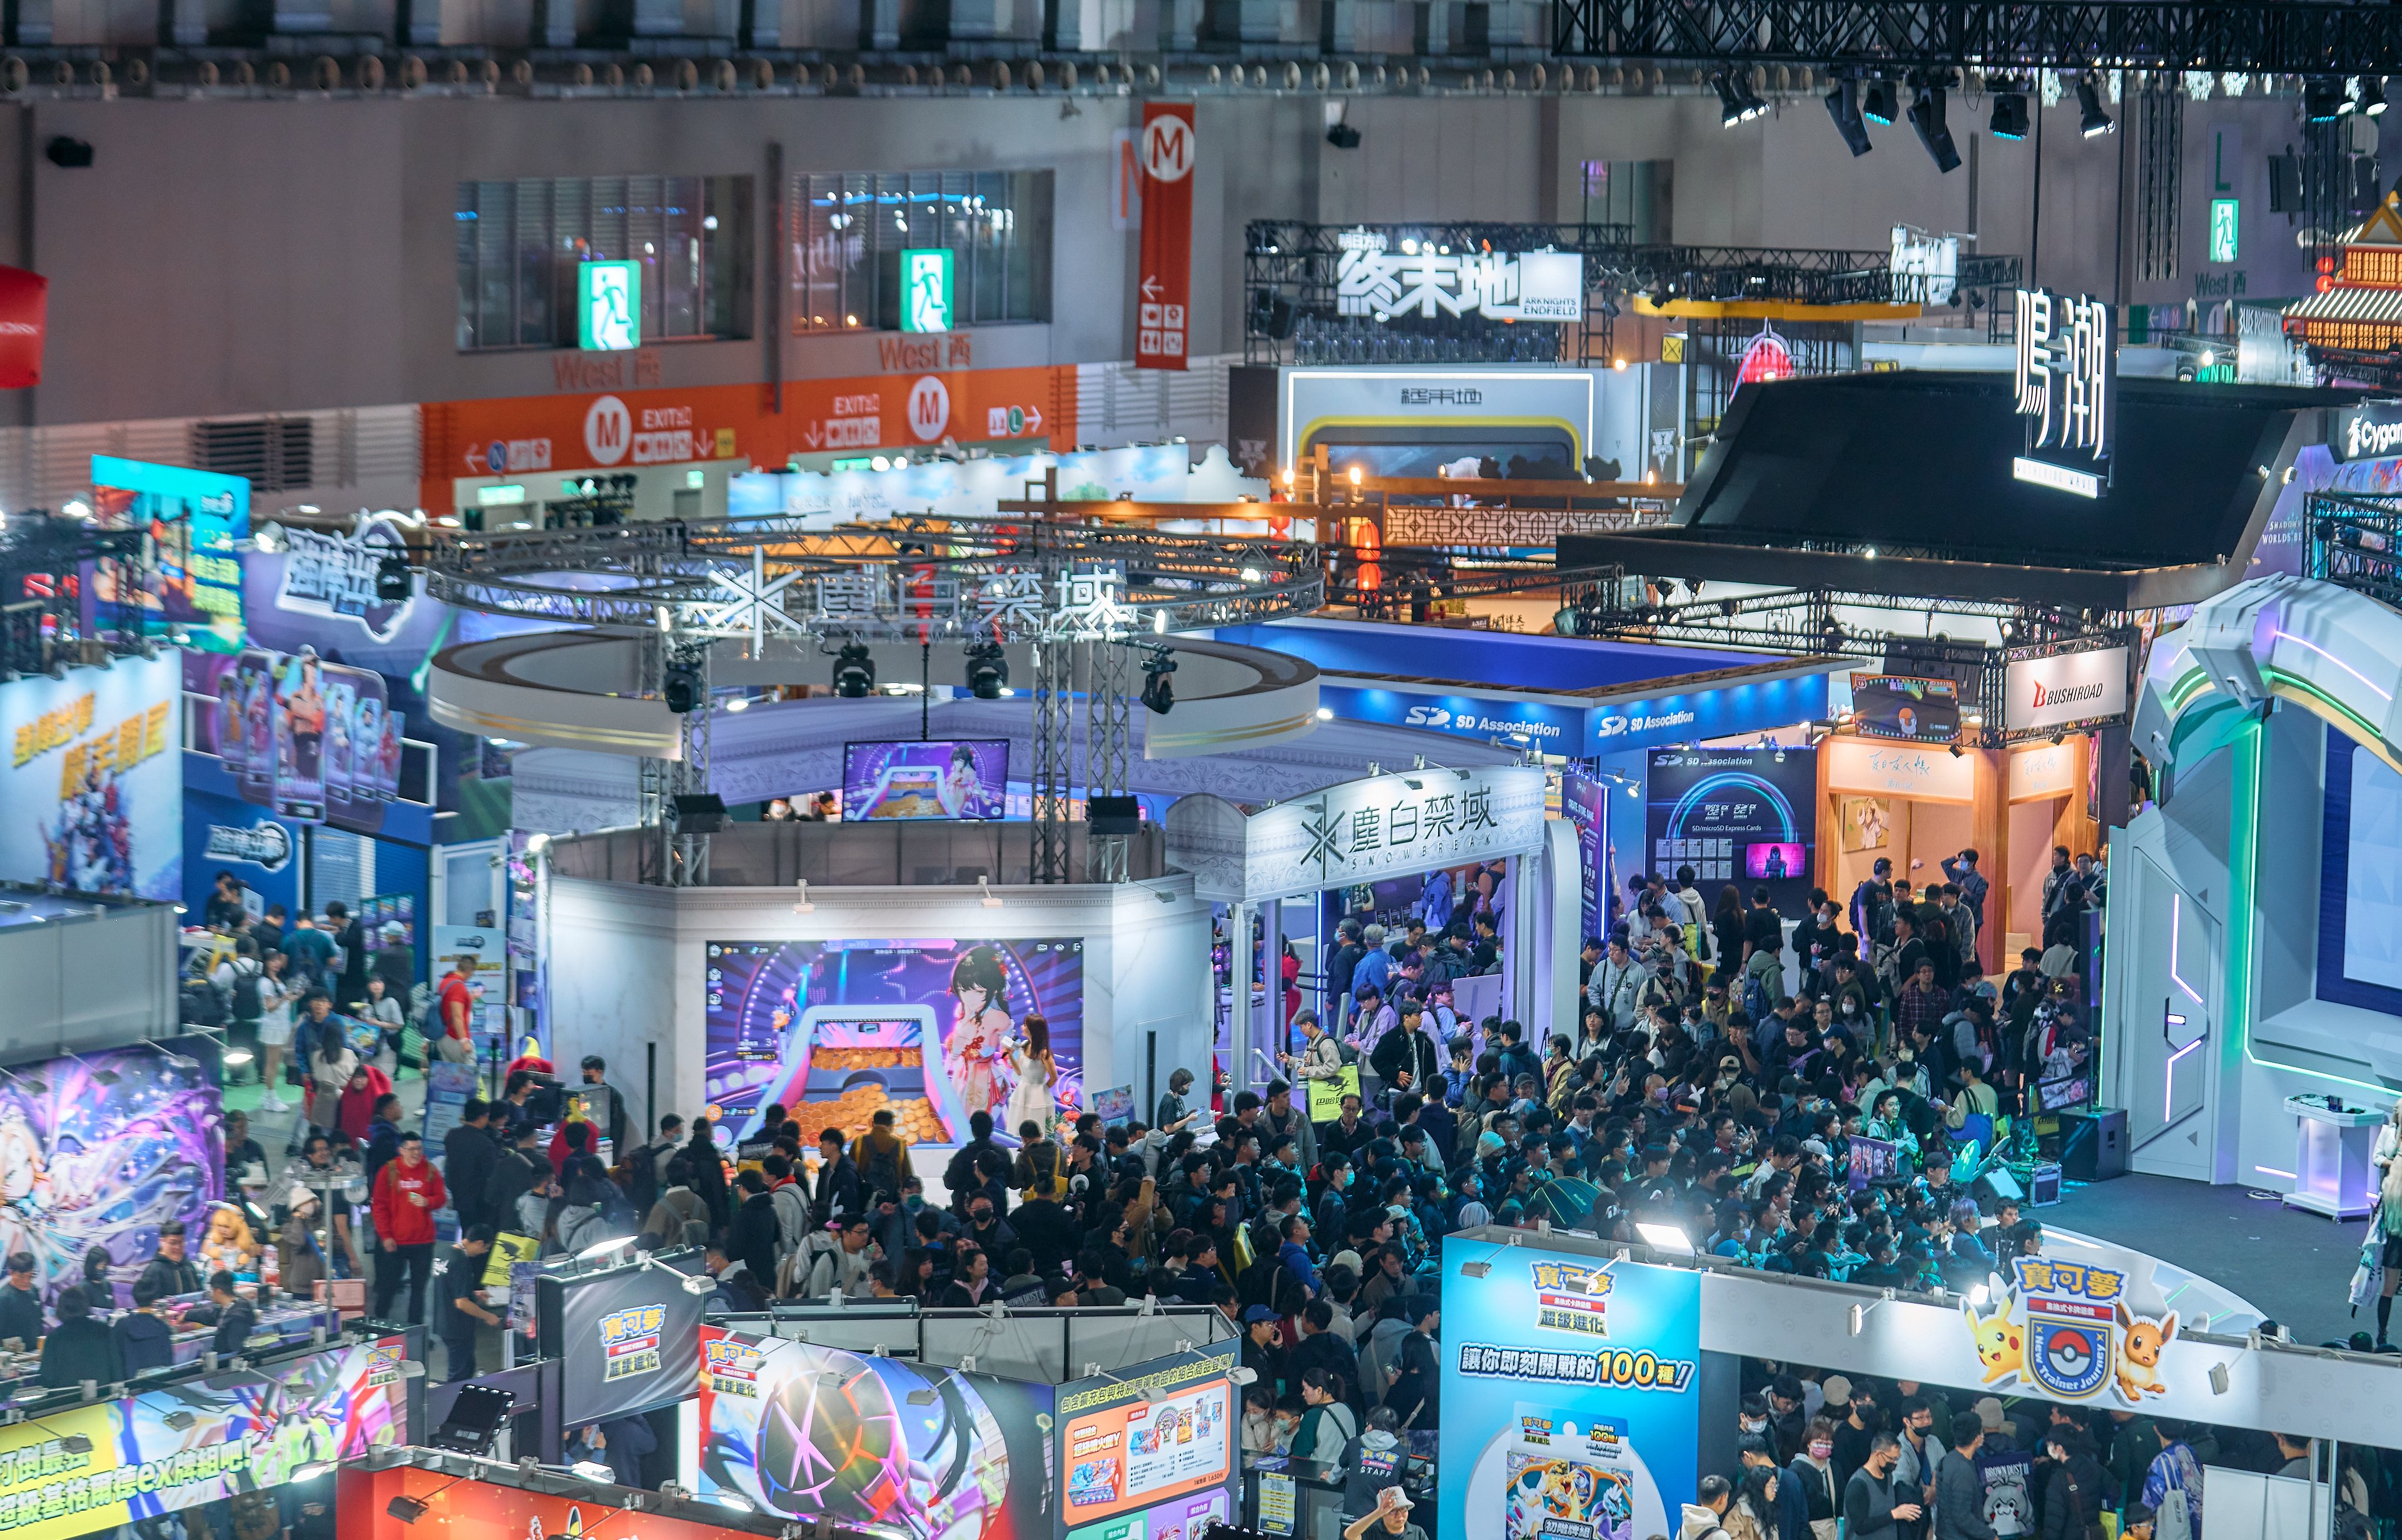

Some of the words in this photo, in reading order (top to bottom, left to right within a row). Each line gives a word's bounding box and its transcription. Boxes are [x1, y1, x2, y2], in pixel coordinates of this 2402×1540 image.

[1153, 127, 1183, 170] M
[2216, 131, 2231, 191] L
[1337, 249, 1519, 320] 終末地
[2196, 272, 2229, 296] West
[2234, 270, 2247, 295] 西
[1524, 305, 1576, 315] ENDFIELD
[1525, 297, 1576, 306] ARKNIGHTS
[879, 337, 940, 371] West
[948, 334, 971, 366] 西
[553, 354, 623, 390] West
[2016, 287, 2107, 461] 鳴潮
[642, 408, 676, 428] EXIT
[834, 397, 866, 415] EXIT
[919, 391, 939, 425] M
[597, 412, 621, 448] M
[2069, 475, 2097, 491] WAVES
[2263, 534, 2291, 545] WORLDS
[811, 565, 1133, 624] 塵白禁域
[2047, 682, 2102, 705] BUSHIROAD
[1456, 714, 1475, 729] SD
[1478, 716, 1561, 737] Association
[1631, 717, 1643, 731] SD
[1646, 709, 1695, 729] Association
[1687, 757, 1700, 766] SD
[1701, 757, 1753, 766] ssociation
[1349, 780, 1497, 853] 塵白禁域
[1352, 833, 1491, 869] SNOWBREAK
[2019, 1262, 2124, 1299] 寶可夢
[602, 1306, 664, 1342] 寶可夢
[1539, 1309, 1606, 1335] 超級進化
[2034, 1335, 2044, 1364] New
[609, 1352, 660, 1380] 超級進化
[1461, 1346, 1691, 1387] 讓你即刻開戰的100種!
[2038, 1365, 2079, 1391] Trainer
[2080, 1342, 2107, 1391] Journey
[1208, 1472, 1224, 1482] 1,650元
[1360, 1466, 1392, 1477] STAFF
[1984, 1466, 2007, 1481] BROWN
[2007, 1461, 2023, 1476] DUST
[1191, 1503, 1208, 1514] 組合內容
[1108, 1527, 1126, 1539] 組合內容
